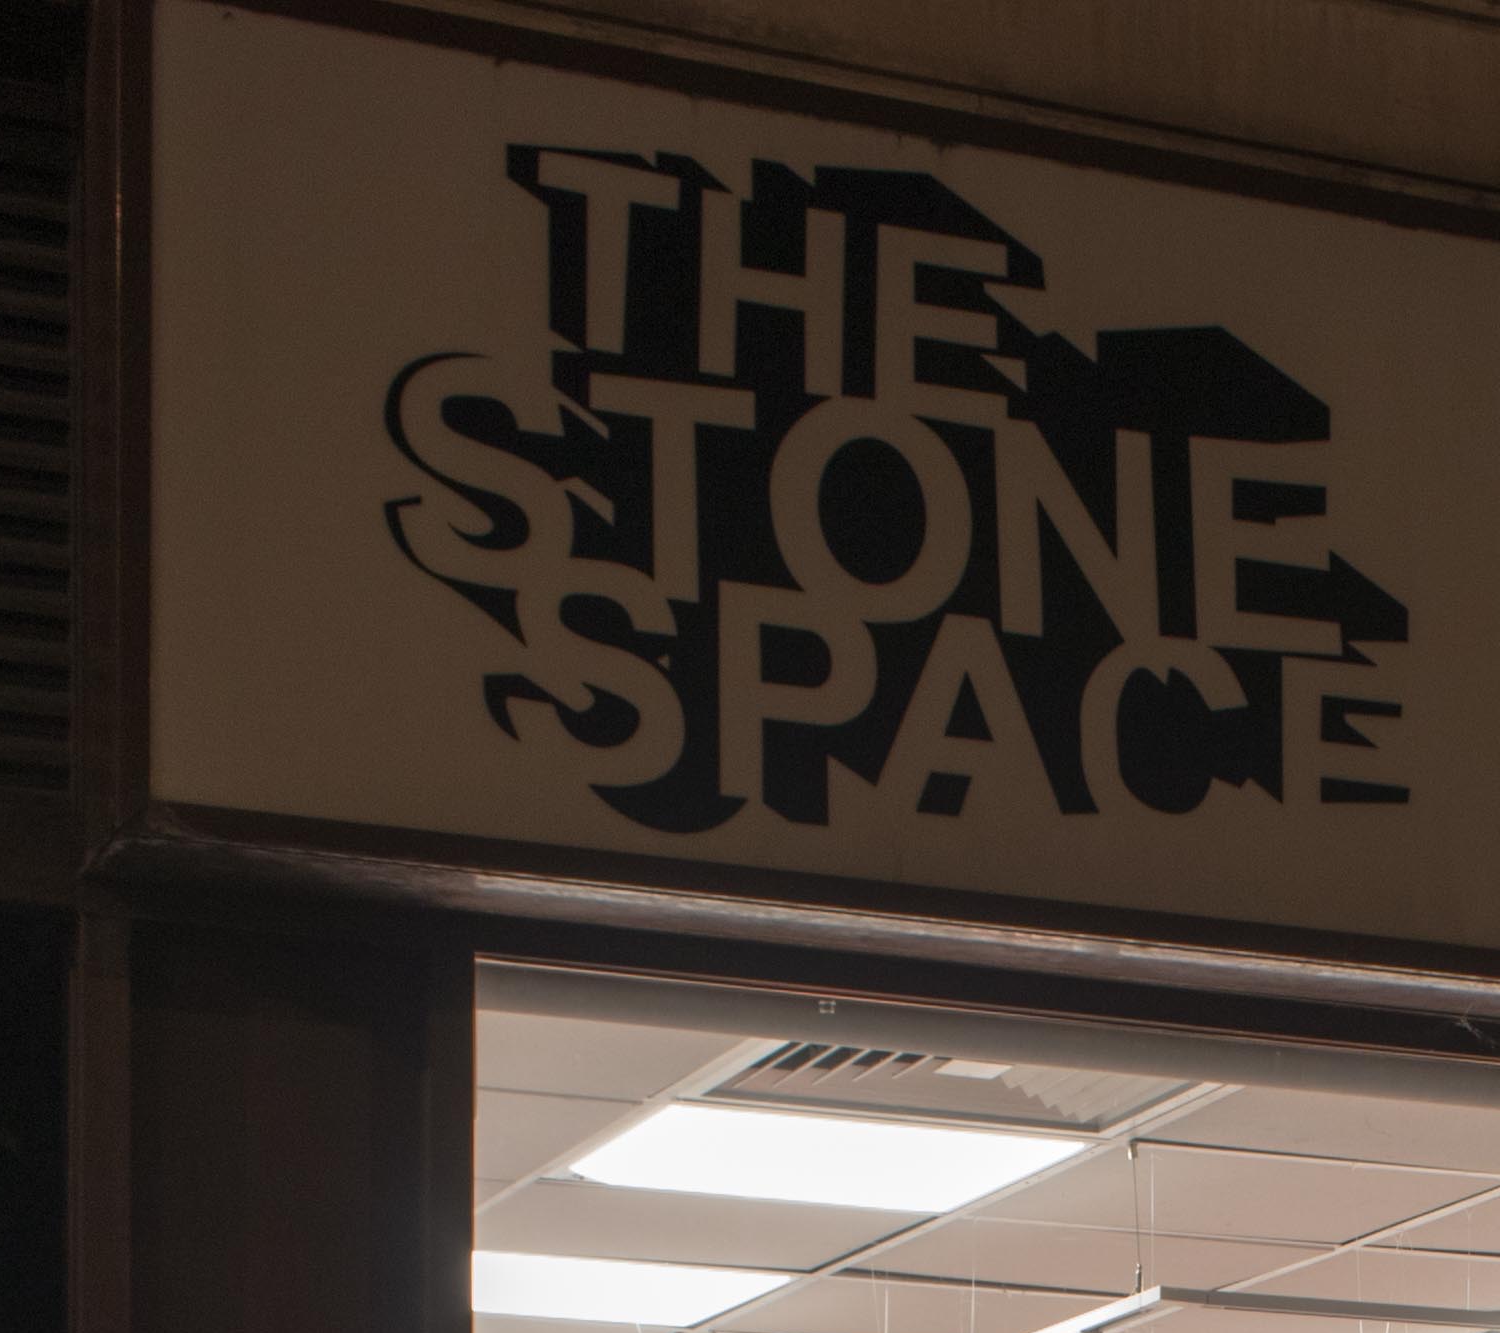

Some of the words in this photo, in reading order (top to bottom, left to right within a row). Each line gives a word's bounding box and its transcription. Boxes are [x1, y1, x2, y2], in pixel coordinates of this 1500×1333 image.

[510, 143, 1045, 402] THE
[385, 350, 1360, 660] STONE
[485, 560, 1412, 828] SPACE
